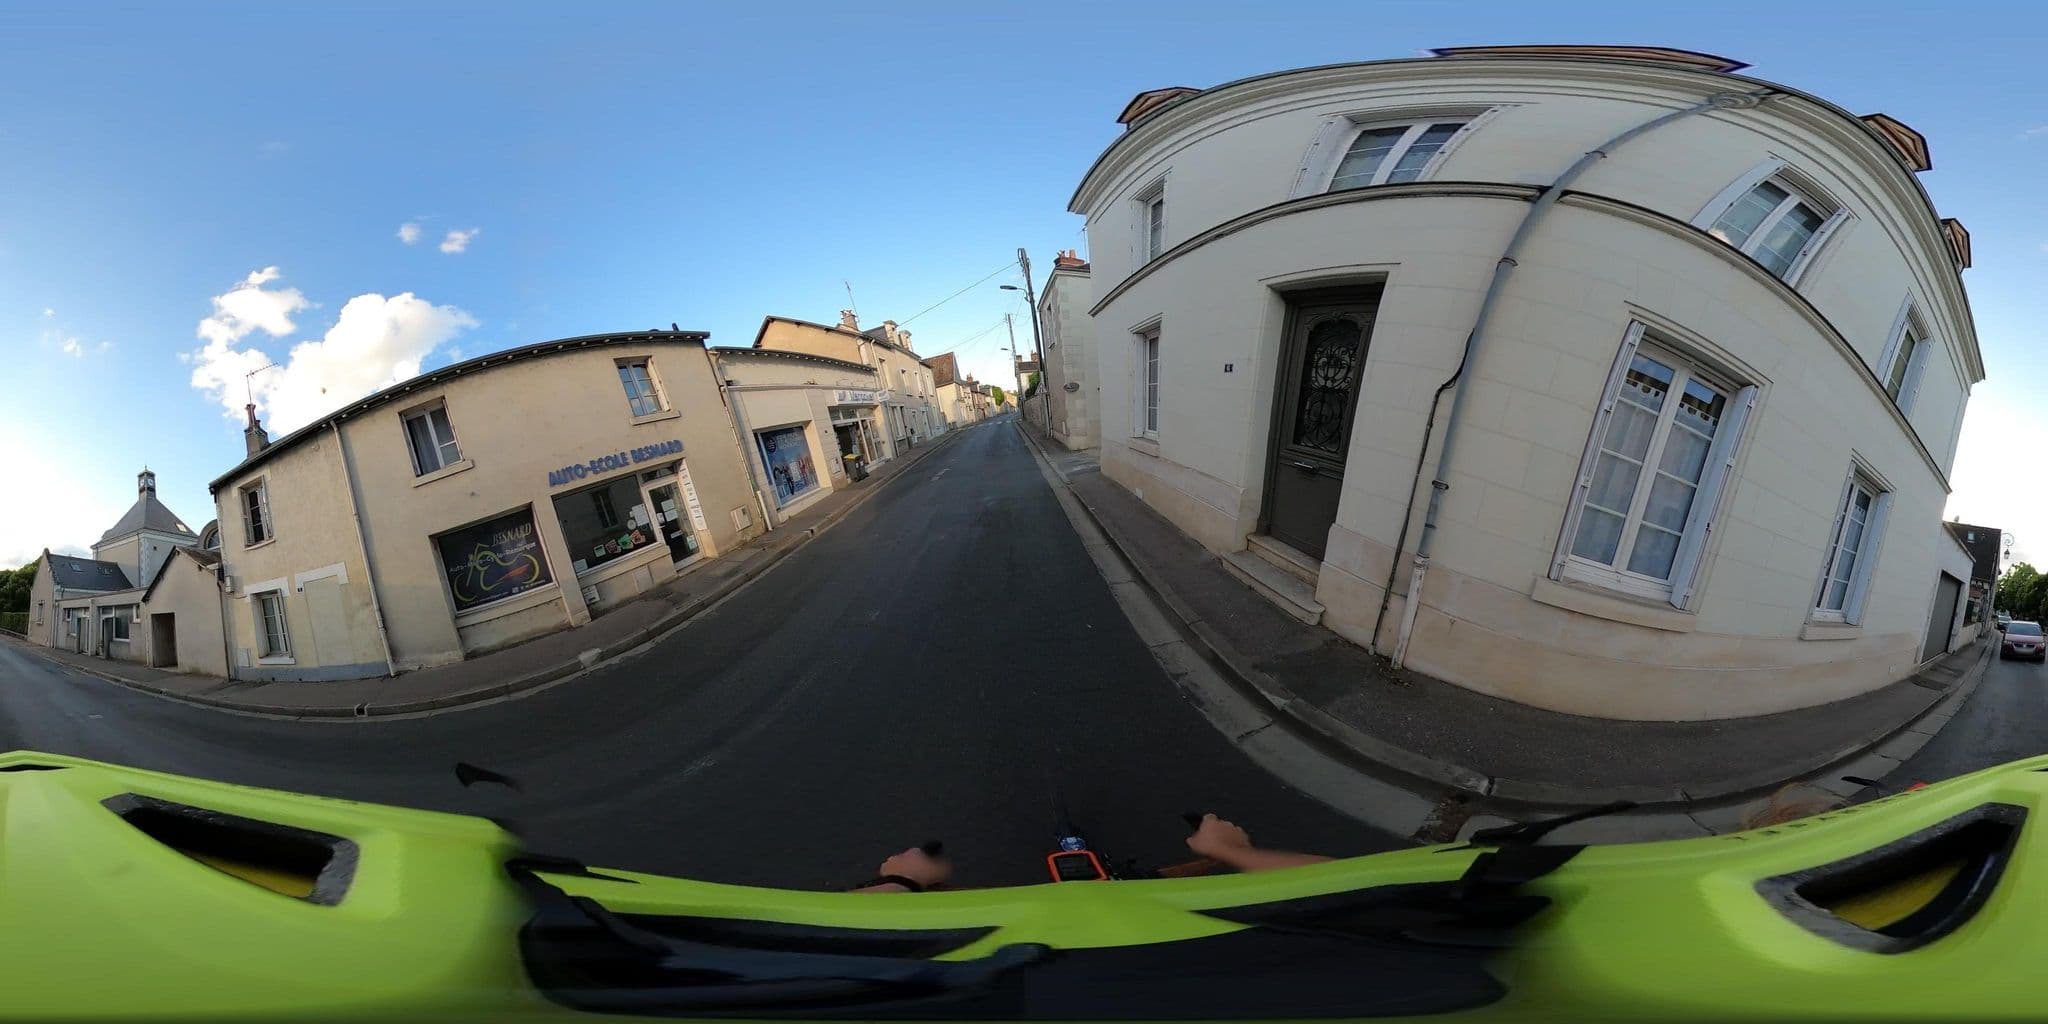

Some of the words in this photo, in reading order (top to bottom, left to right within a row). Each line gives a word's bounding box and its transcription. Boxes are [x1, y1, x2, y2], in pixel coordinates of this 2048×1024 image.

[549, 452, 630, 486] AUTO-ECOLE
[631, 439, 684, 463] BESNARD
[492, 522, 532, 547] BESNARD
